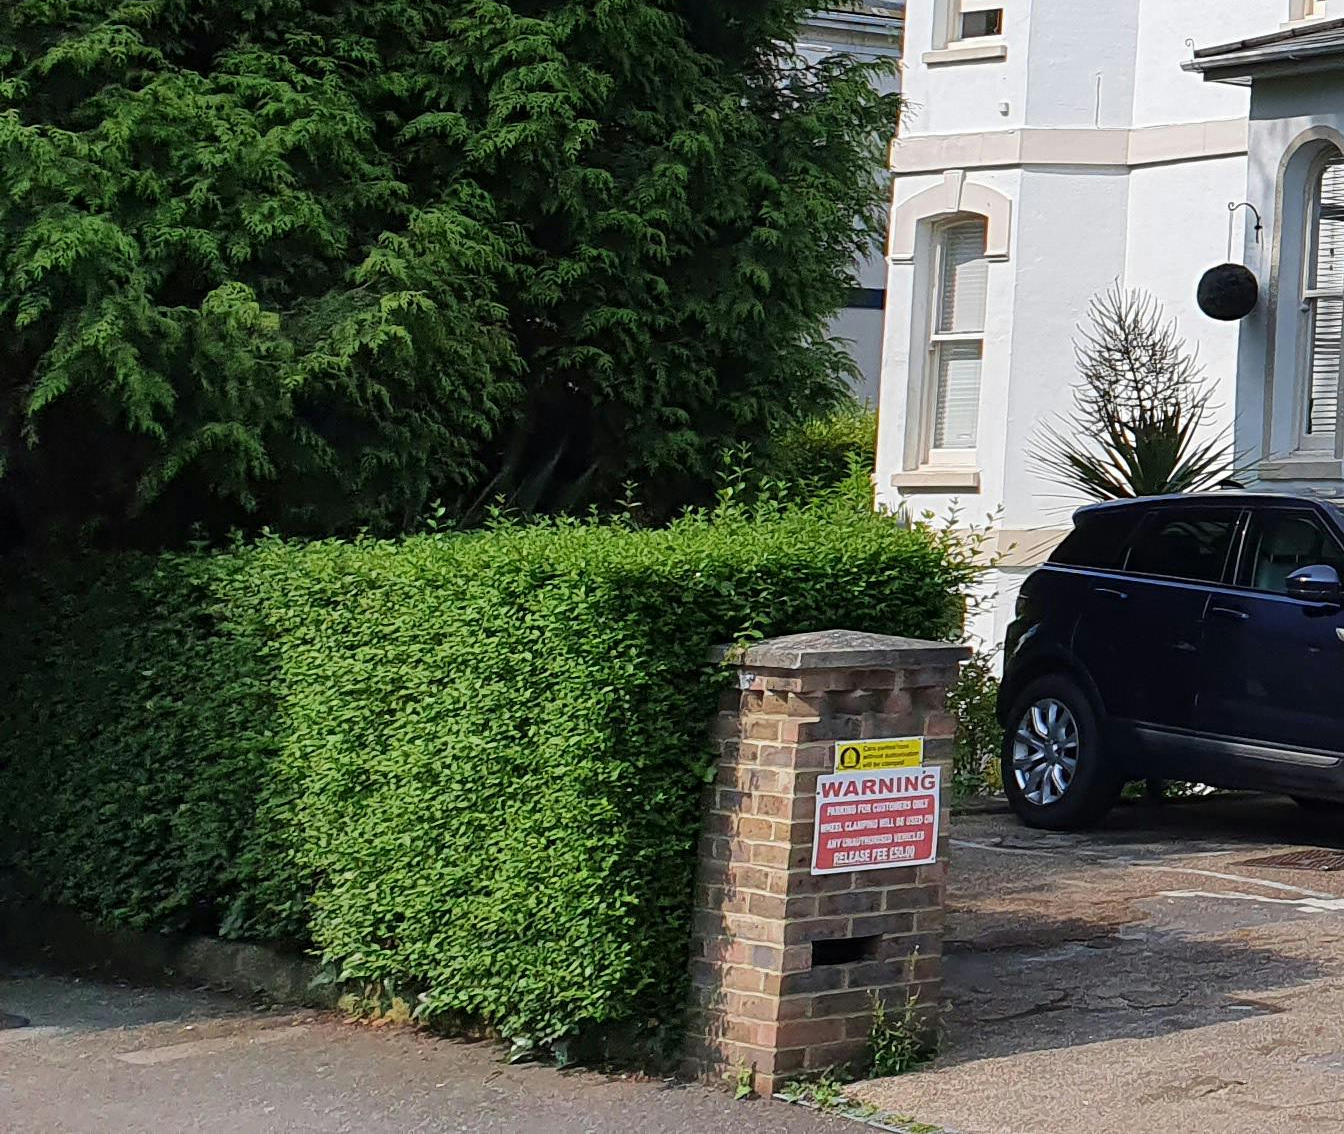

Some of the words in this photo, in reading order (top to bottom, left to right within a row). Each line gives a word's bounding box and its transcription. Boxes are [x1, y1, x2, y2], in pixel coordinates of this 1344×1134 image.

[821, 774, 936, 799] WARNING
[827, 805, 857, 816] PARKING
[857, 803, 872, 814] FOR
[844, 819, 878, 831] CLAMPING
[879, 817, 895, 828] WILL
[827, 838, 842, 849] ANY
[833, 849, 871, 866] RELEASE
[871, 847, 889, 862] FEE
